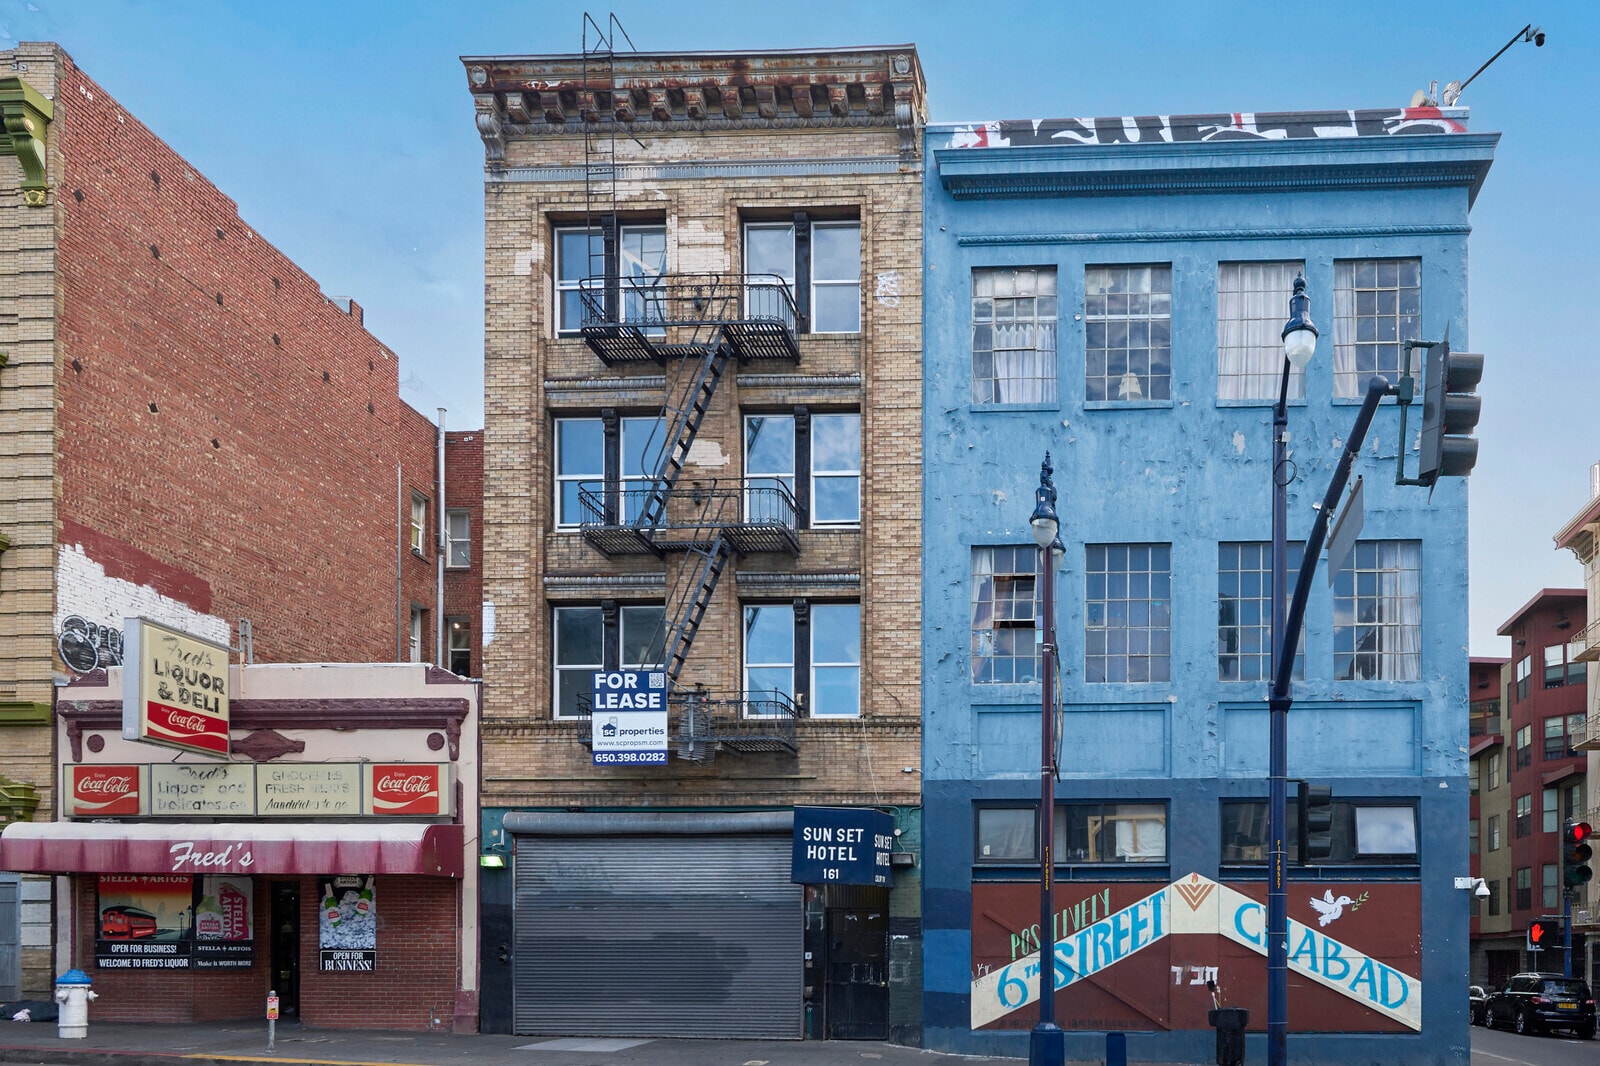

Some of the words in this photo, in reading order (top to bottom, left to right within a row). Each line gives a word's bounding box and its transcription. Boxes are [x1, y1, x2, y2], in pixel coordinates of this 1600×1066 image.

[154, 658, 225, 695] LIQUOR
[595, 673, 637, 689] FOR
[158, 681, 175, 701] &
[179, 687, 219, 713] DELI
[595, 693, 661, 709] LEASE
[168, 711, 206, 732] Coca-Cola
[620, 727, 664, 736] properties
[597, 739, 663, 747] www.scpropsm.com
[595, 752, 665, 763] 650.398.0282
[78, 776, 131, 793] Coca-Cola
[159, 781, 206, 797] Liquor
[377, 775, 431, 793] Coca-Cola
[803, 827, 832, 841] SUN
[836, 828, 864, 843] SET
[874, 834, 884, 848] SUN
[884, 836, 893, 850] SET
[169, 841, 254, 871] Fred's
[807, 845, 857, 861] HOTEL
[876, 851, 890, 866] HOTEL
[100, 875, 138, 883] STELLA
[150, 875, 189, 883] ARTOIS
[823, 868, 839, 879] 161
[223, 897, 232, 939] ARTOIS
[233, 897, 243, 938] STELLA
[1011, 888, 1110, 961] POSTIVELY
[1053, 890, 1166, 990] STREET
[111, 944, 128, 953] OPEN
[129, 944, 142, 953] FOR
[143, 944, 177, 954] BUSINESS!
[333, 952, 350, 960] OPEN
[351, 952, 364, 960] FOR
[1234, 903, 1409, 1009] CABAD
[99, 958, 132, 968] WELCOME
[132, 958, 141, 968] TO
[142, 958, 164, 968] FRED'S
[164, 958, 189, 969] LIQUOR
[325, 960, 372, 971] BUSINESS!
